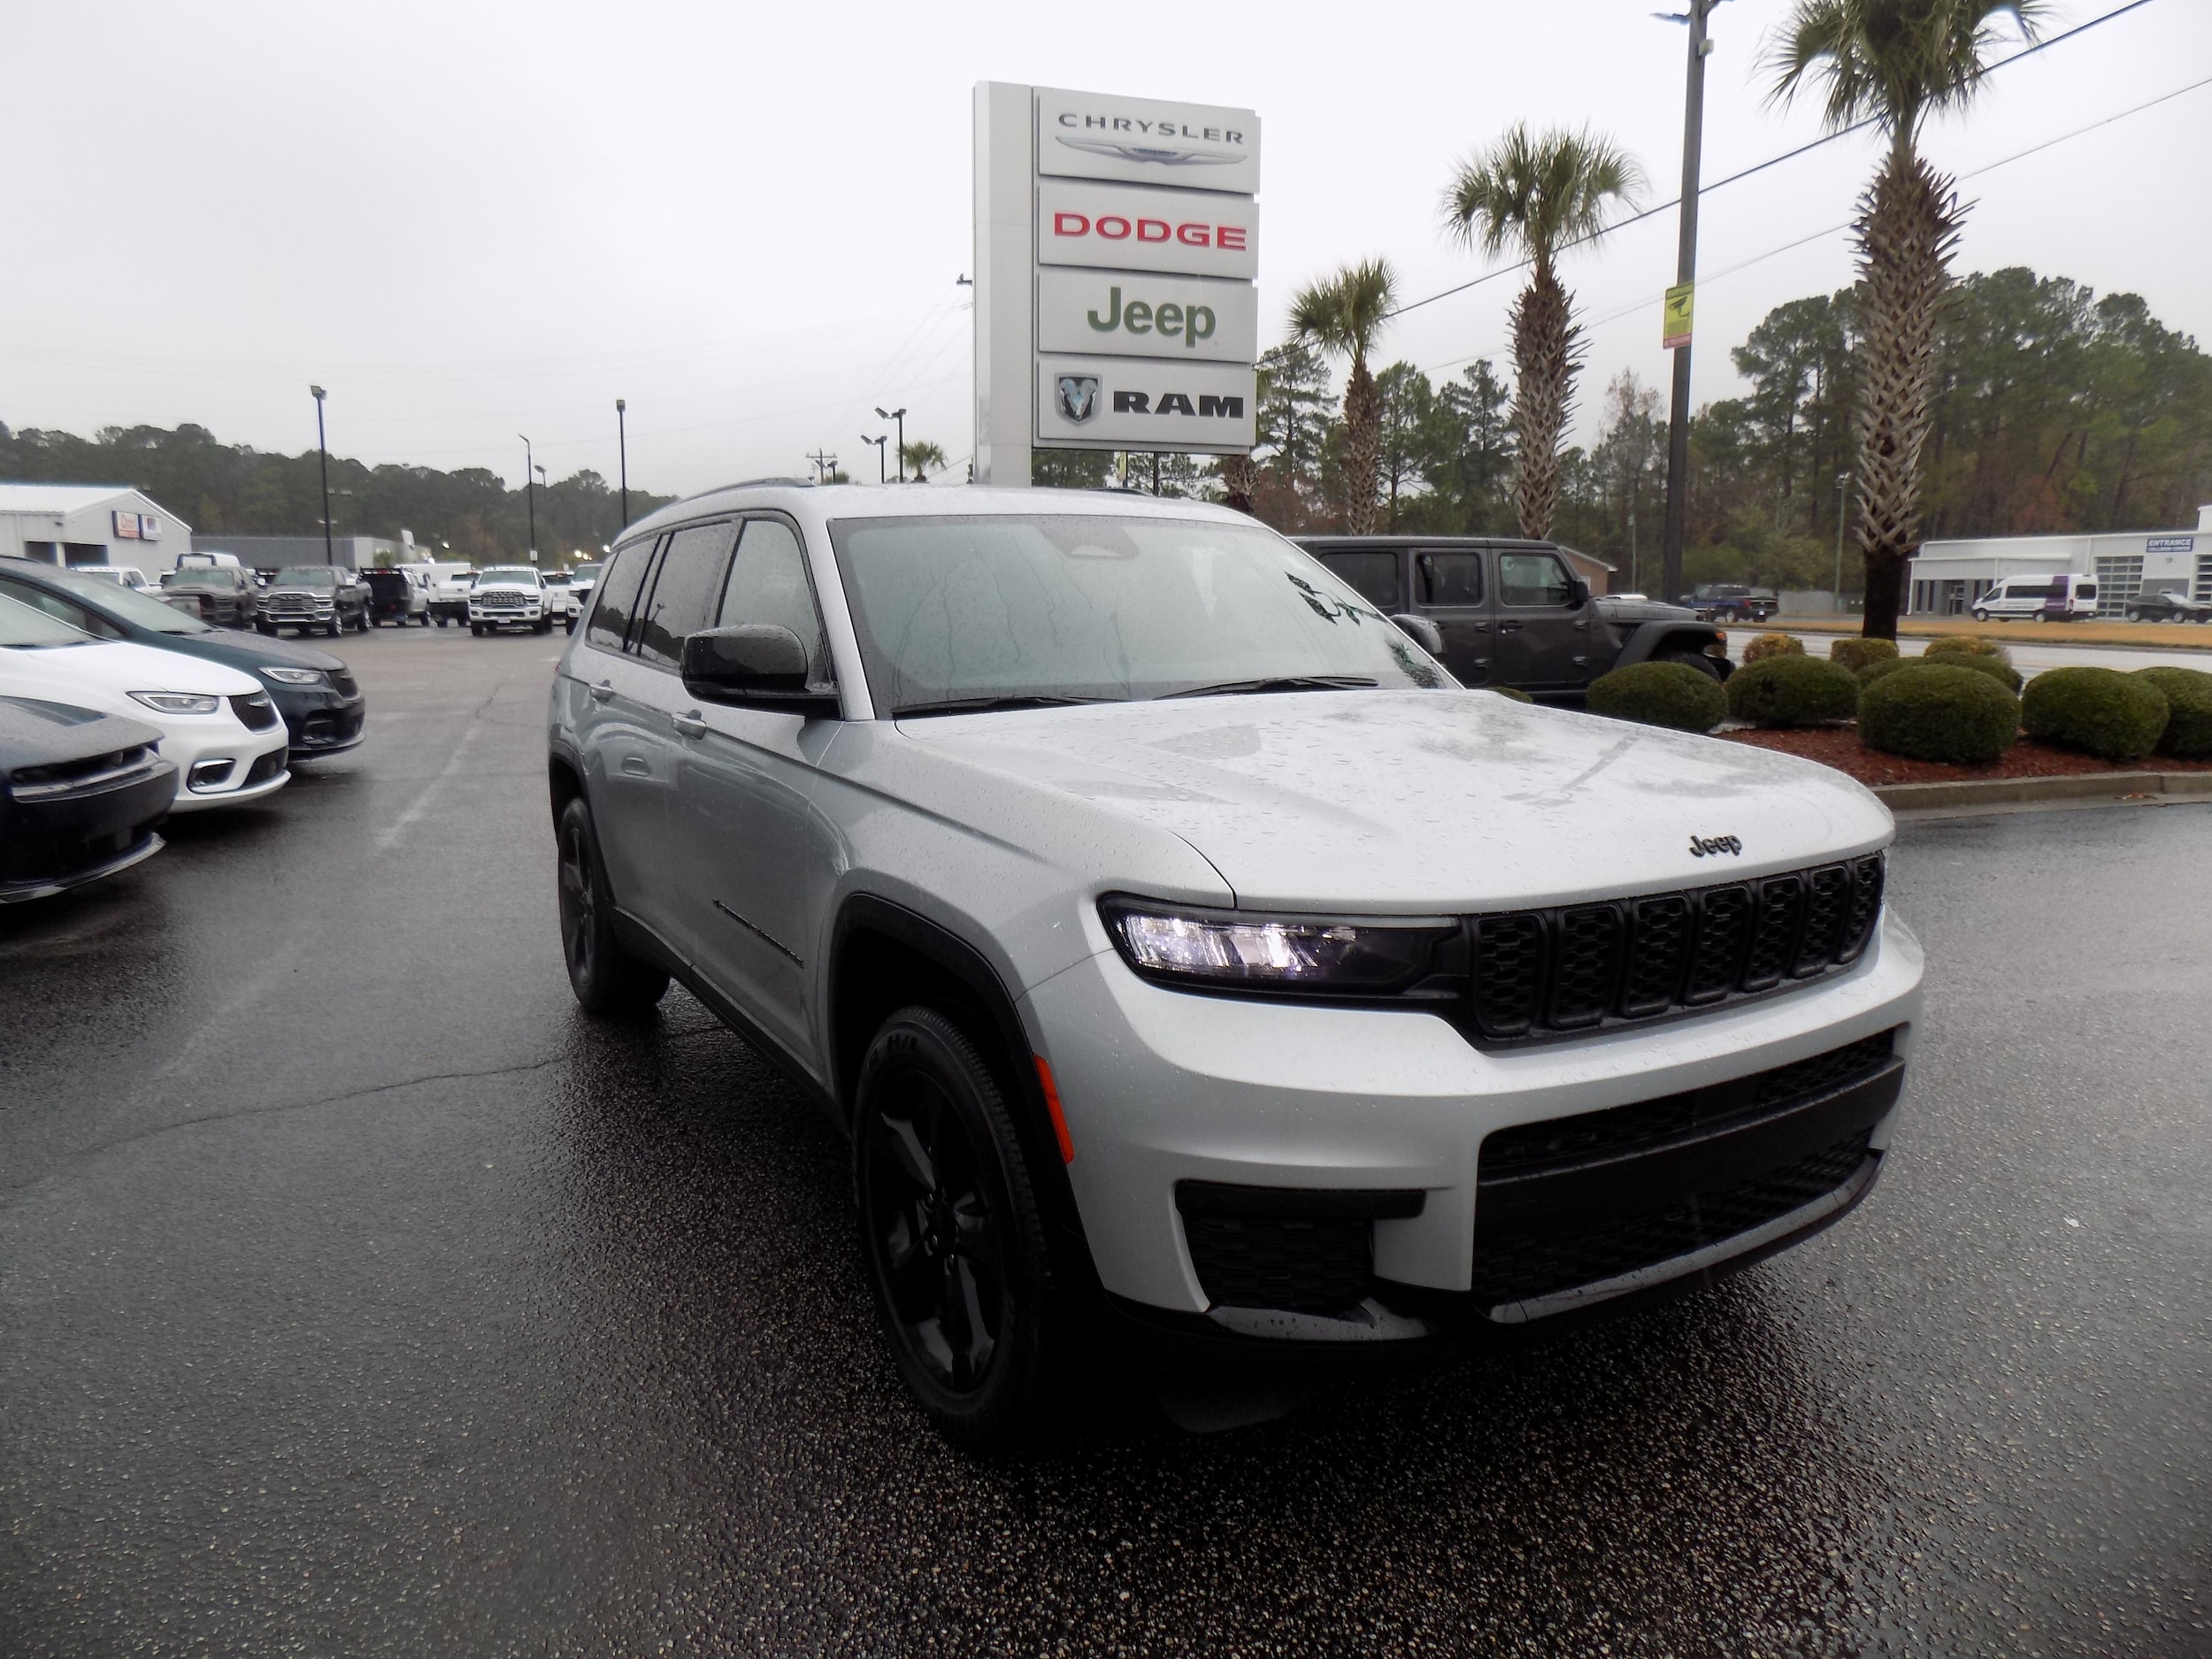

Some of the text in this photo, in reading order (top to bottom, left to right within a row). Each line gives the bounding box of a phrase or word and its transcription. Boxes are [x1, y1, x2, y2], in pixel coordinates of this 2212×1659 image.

[1058, 113, 1243, 144] CHRYSLER
[1054, 212, 1247, 251] DODGE
[1087, 286, 1216, 348] Jeep
[1113, 390, 1244, 419] RAM
[1689, 834, 1742, 858] Jeep
